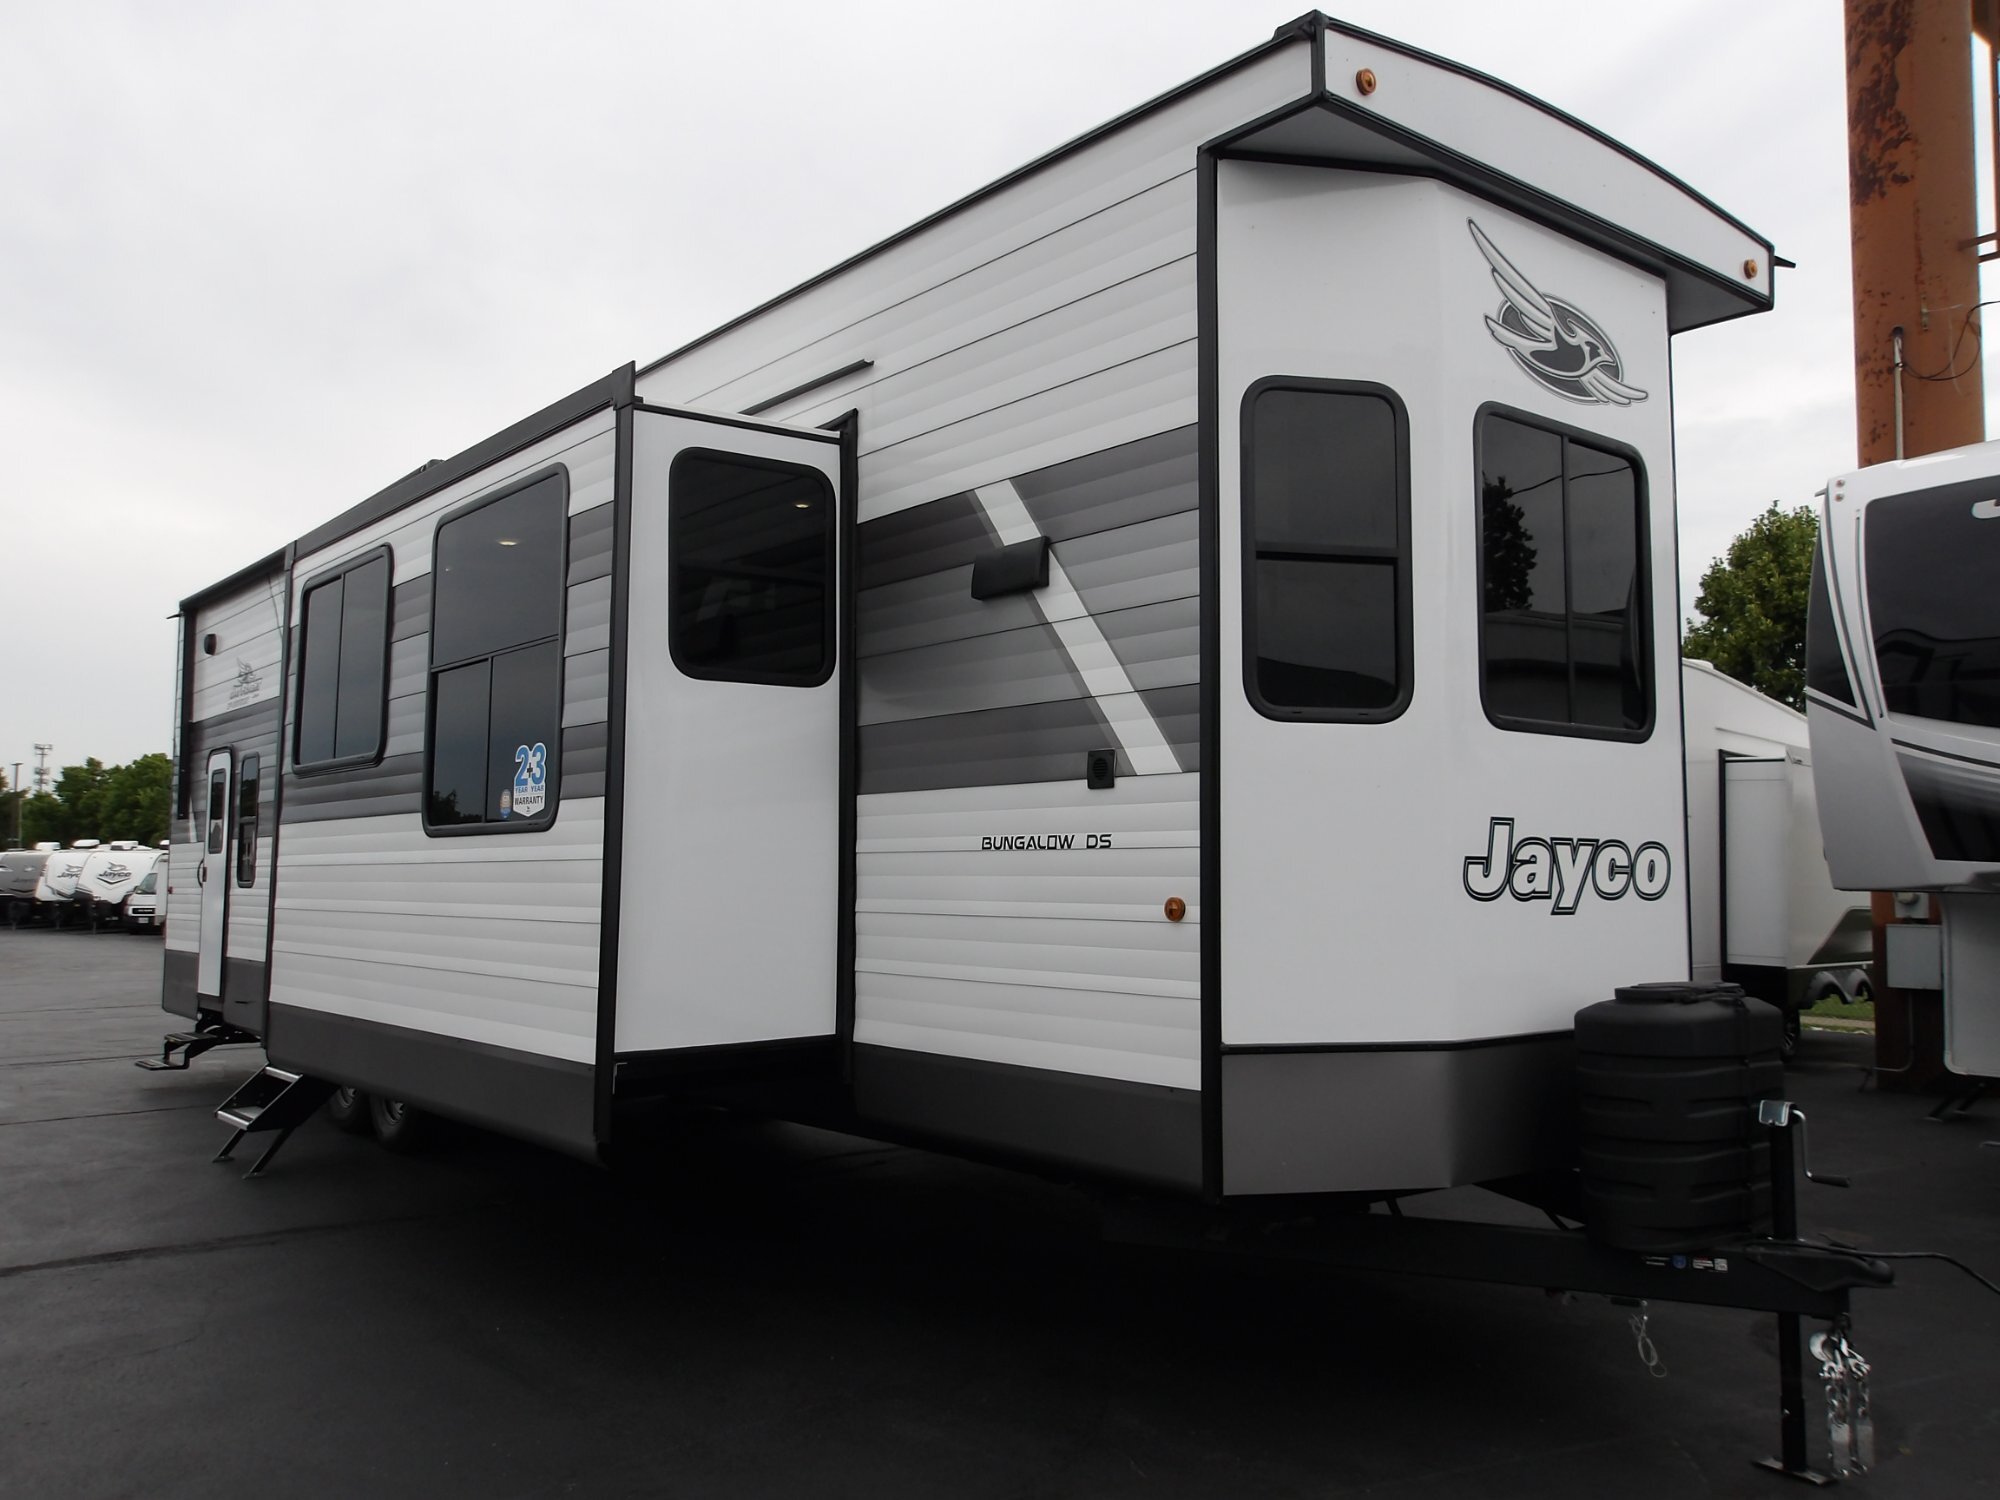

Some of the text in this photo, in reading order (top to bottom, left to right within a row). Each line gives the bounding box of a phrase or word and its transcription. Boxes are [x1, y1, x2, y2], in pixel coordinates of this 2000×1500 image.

[515, 785, 544, 794] YEAR YEAR
[514, 795, 543, 806] WARRANTY
[981, 833, 1113, 850] BUNGALOW DS
[1463, 816, 1671, 915] Jayco
[57, 871, 81, 879] Jayc
[99, 870, 132, 878] Jayco
